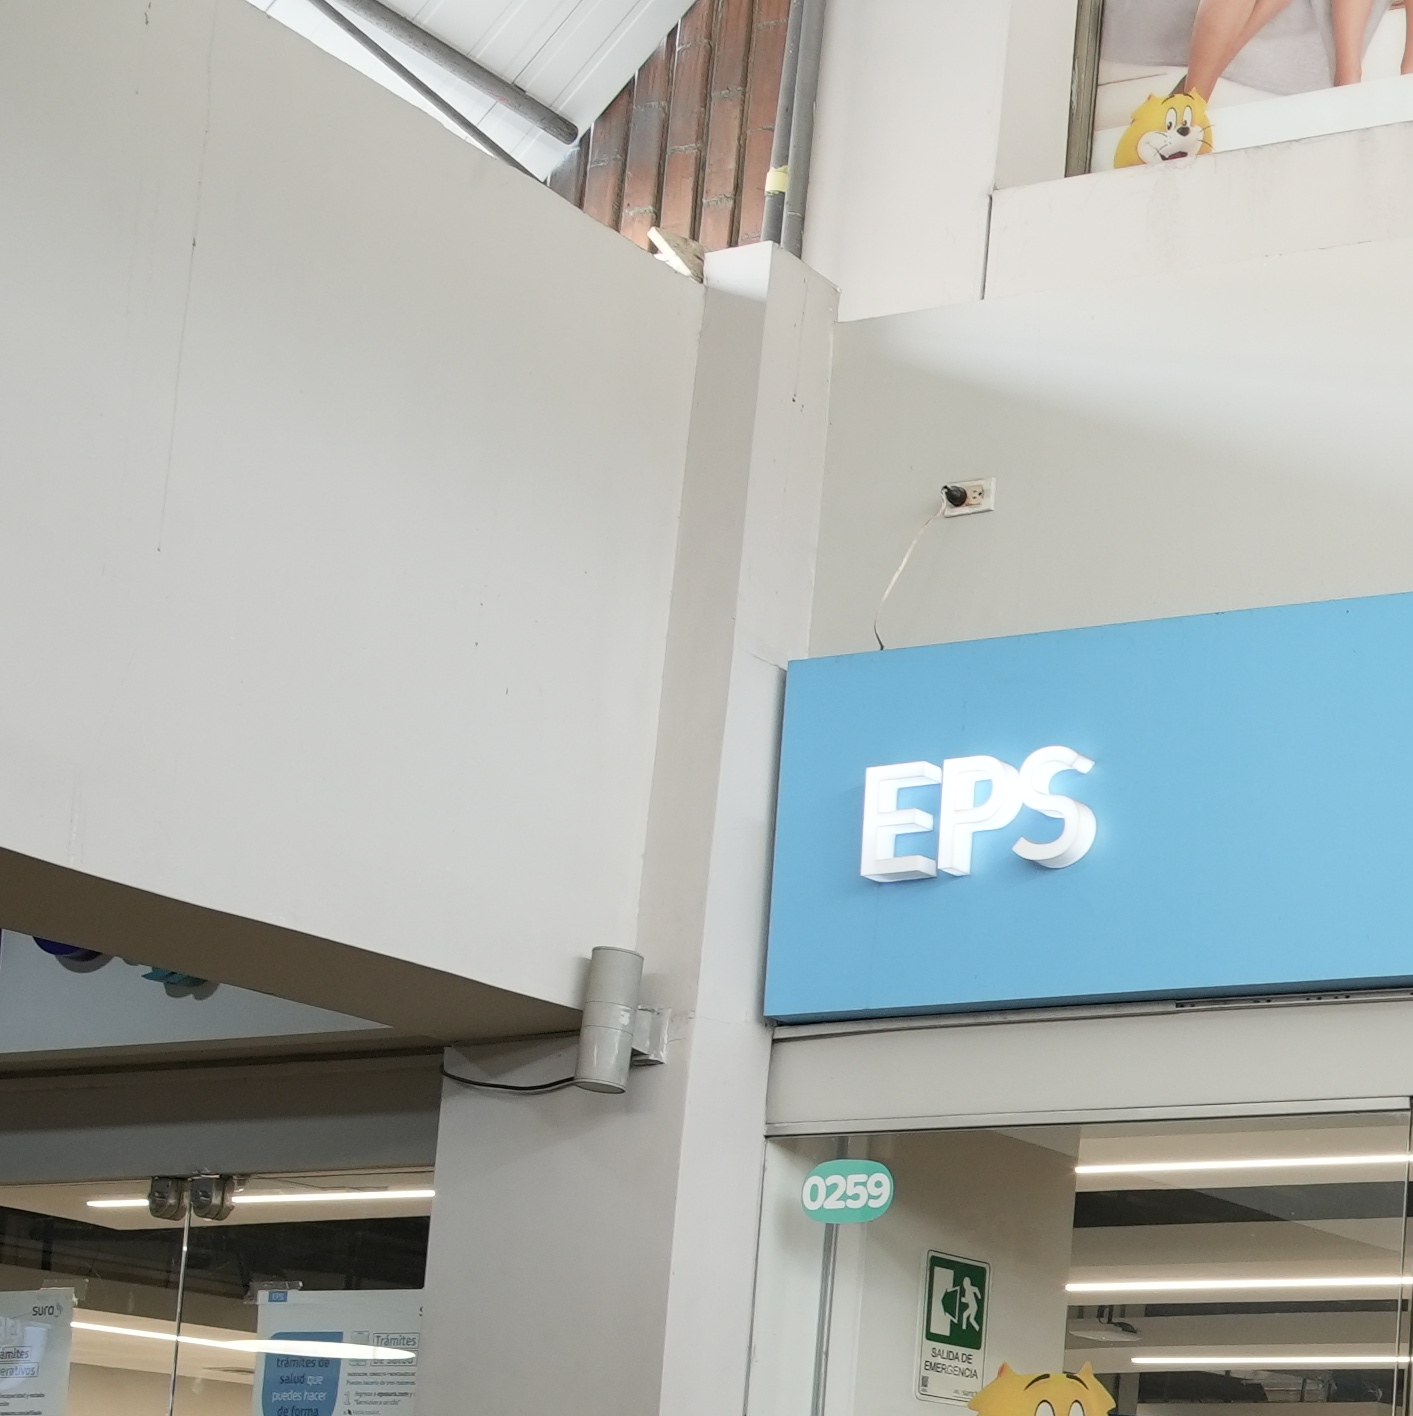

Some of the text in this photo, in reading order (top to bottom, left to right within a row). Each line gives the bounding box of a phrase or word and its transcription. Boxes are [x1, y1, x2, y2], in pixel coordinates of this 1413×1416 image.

[860, 744, 1097, 883] EPS
[802, 1173, 891, 1210] 0259
[32, 1305, 54, 1316] sura
[375, 1335, 417, 1347] Trámites
[276, 1356, 330, 1368] trámites de
[931, 1347, 973, 1365] SALIDA DE
[924, 1360, 978, 1379] EMERGENCIA
[280, 1373, 323, 1387] salud que
[272, 1390, 327, 1403] puedes hacer
[277, 1405, 318, 1416] de forma
